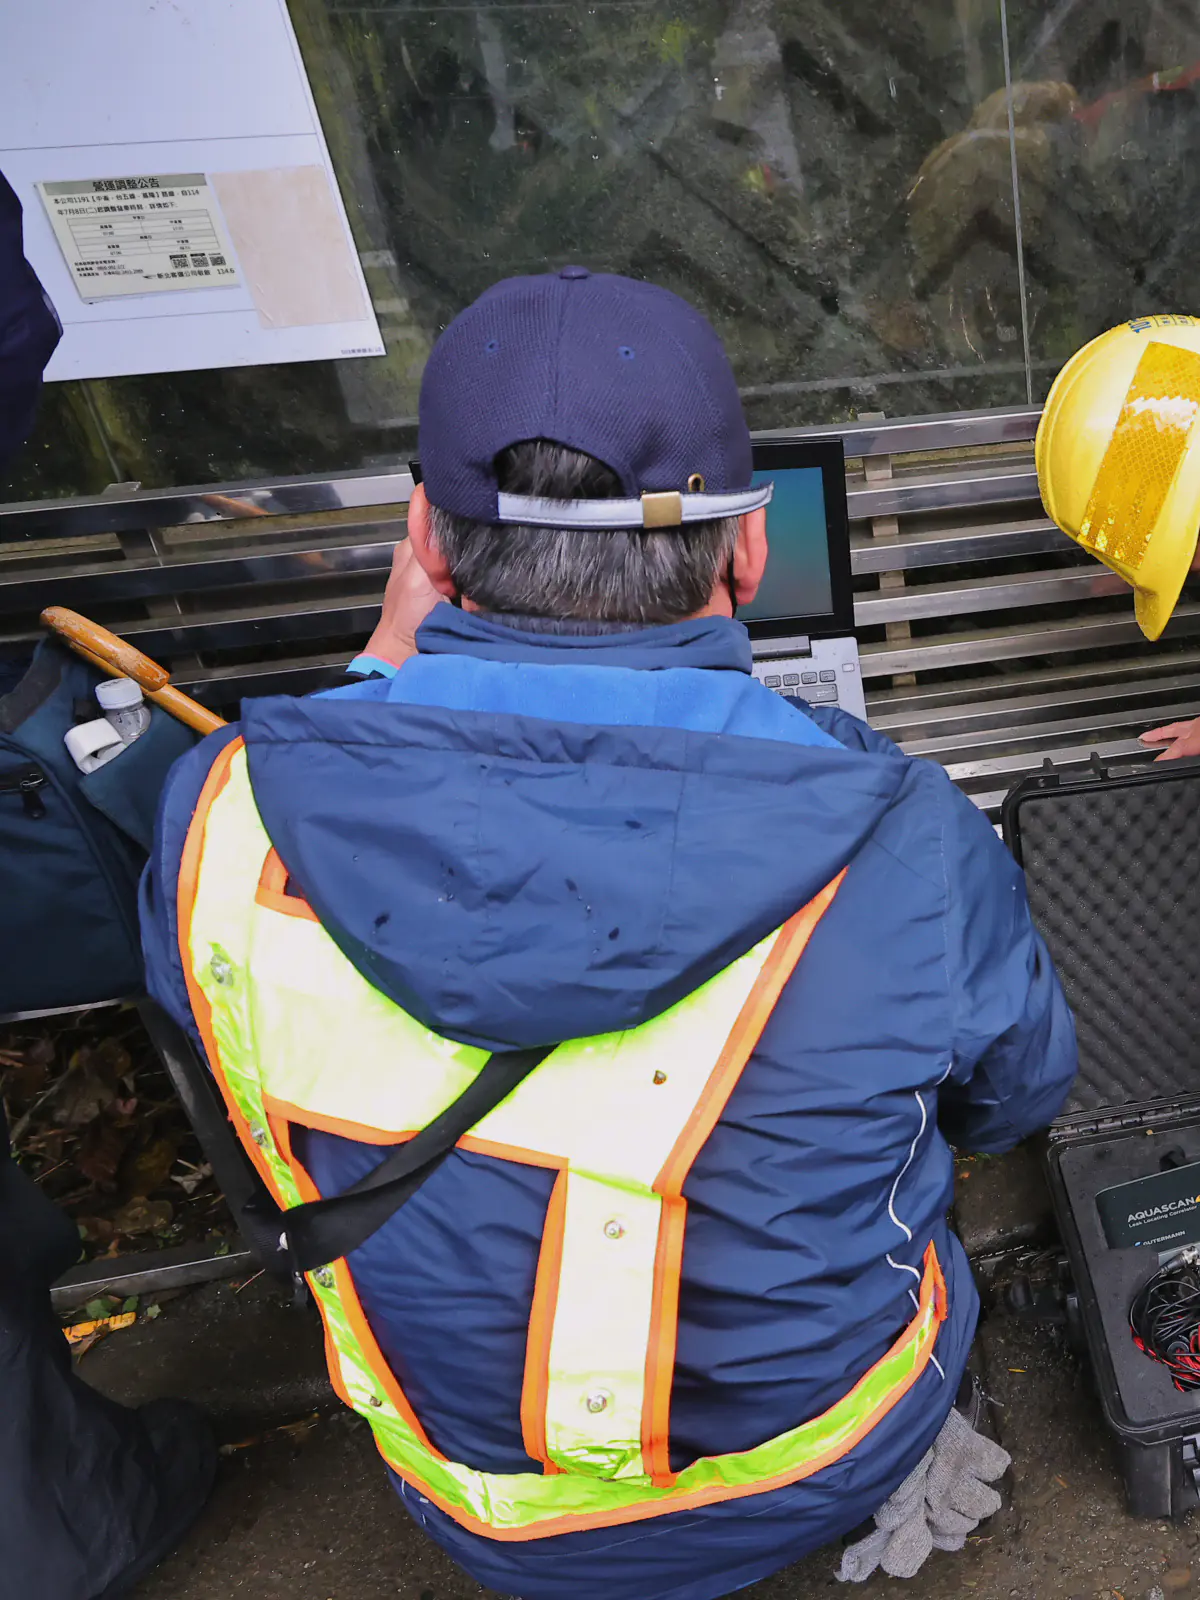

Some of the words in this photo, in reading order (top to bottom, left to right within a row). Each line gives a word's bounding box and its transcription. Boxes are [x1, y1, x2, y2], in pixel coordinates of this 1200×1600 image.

[92, 177, 160, 192] 營運調整公告
[1127, 1196, 1195, 1223] AQUASCAN
[1143, 1213, 1168, 1225] Locating
[1169, 1205, 1197, 1217] Correlator
